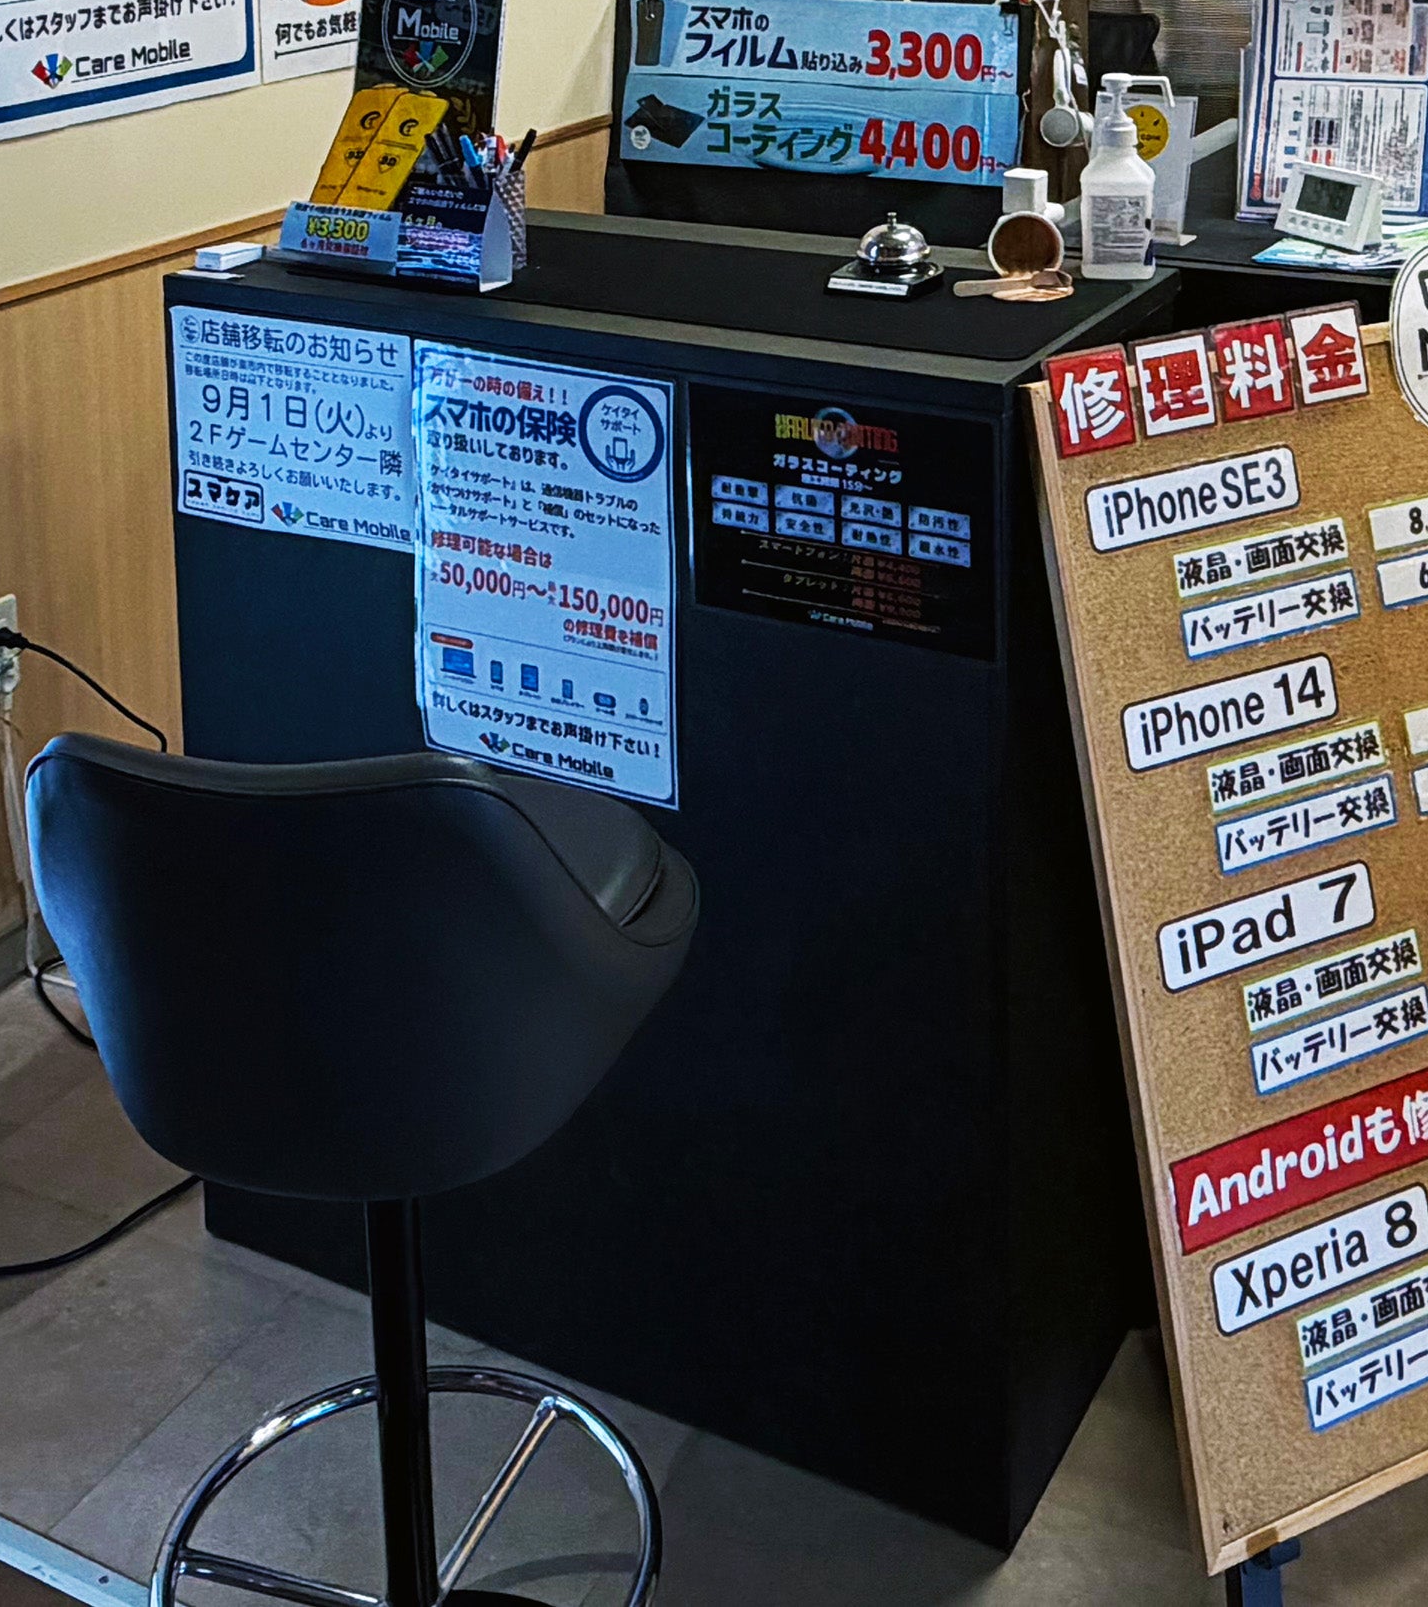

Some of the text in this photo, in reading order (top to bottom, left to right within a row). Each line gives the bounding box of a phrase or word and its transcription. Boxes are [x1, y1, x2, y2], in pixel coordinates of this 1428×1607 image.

[396, 7, 459, 40] Mobile
[688, 5, 770, 32] スマホの
[75, 40, 191, 78] Care Mobile
[707, 87, 782, 119] ガラス
[706, 121, 853, 162] コーティング
[200, 320, 398, 367] 店舗移転のお知らせ
[1059, 321, 1367, 446] 修理料金
[425, 394, 577, 448] スマホの保険
[600, 419, 641, 436] サポート
[601, 404, 639, 420] ケイタイ
[188, 450, 401, 501] 引き続きよろしくお願いいたします。
[772, 453, 902, 484] ガラスコーティング
[187, 477, 260, 510] スマケア
[306, 510, 412, 542] Care Mobile
[432, 531, 552, 569] 修理可能な場合は
[1177, 525, 1346, 589] 液晶・画面交換
[1189, 575, 1356, 647] バッテリー交換
[1140, 665, 1326, 756] iPhone 14
[1211, 731, 1380, 805] 液晶・画面交換
[1224, 788, 1391, 861] バッテリー交換
[1177, 872, 1358, 974] iPad 7
[1247, 939, 1418, 1023] 液晶・画面交換
[1259, 998, 1428, 1080] バッテリー交換
[1234, 1198, 1419, 1316] Xperia 8
